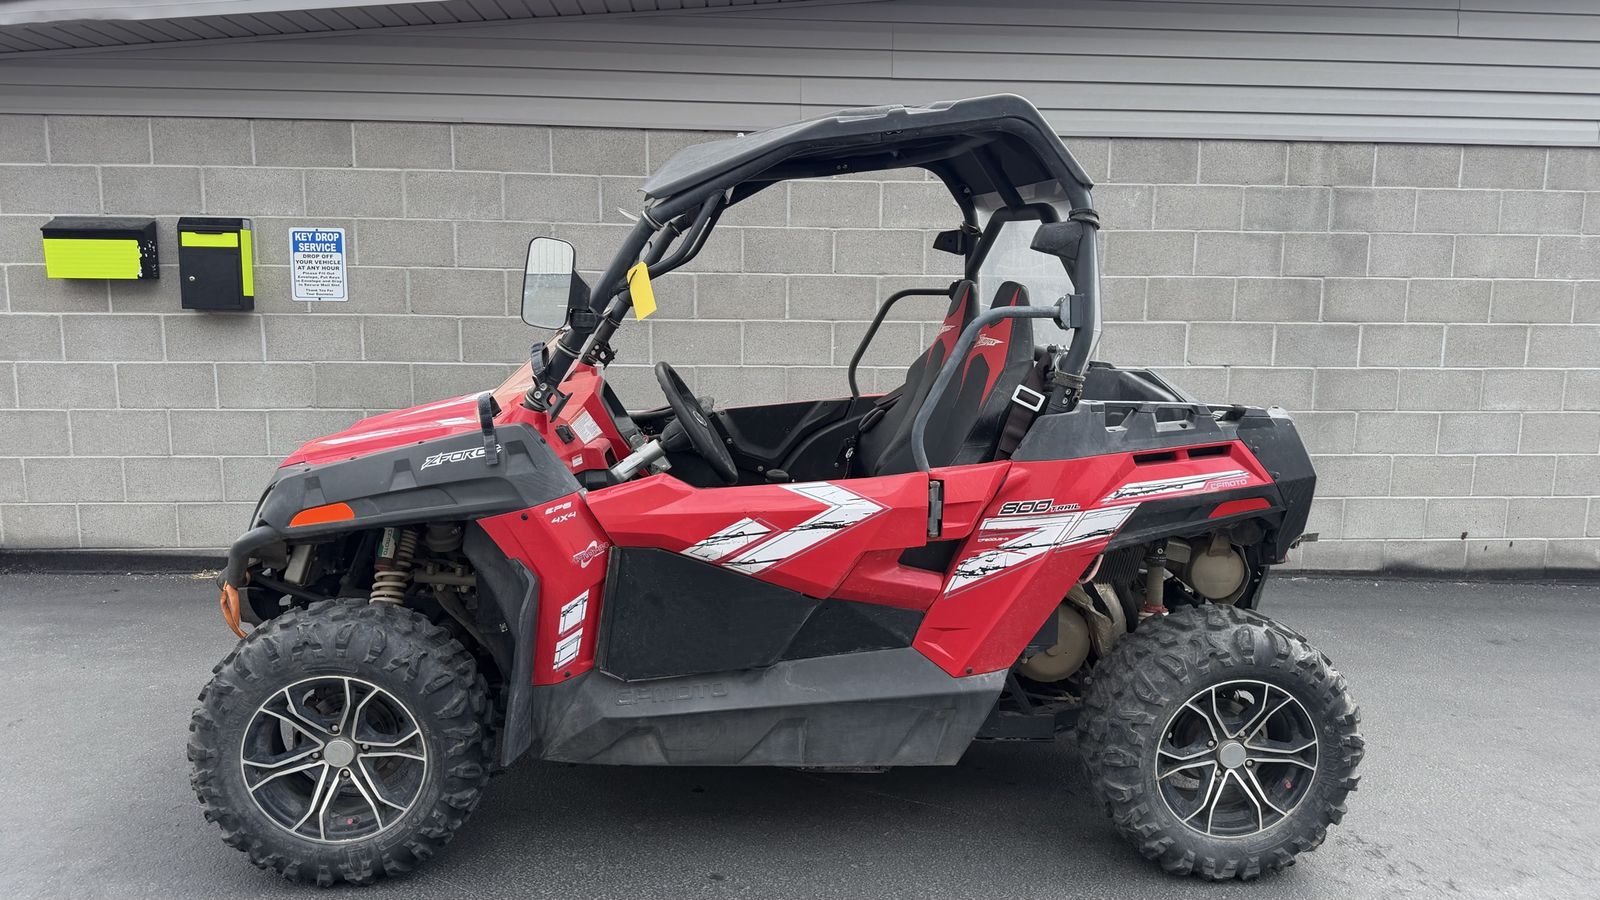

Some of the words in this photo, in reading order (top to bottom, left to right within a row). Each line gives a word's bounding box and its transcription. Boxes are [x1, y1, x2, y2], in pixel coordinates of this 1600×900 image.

[294, 232, 313, 241] KEY
[315, 232, 339, 242] DROP
[298, 242, 337, 252] SERVICE
[1210, 478, 1248, 490] CFMOTO
[544, 501, 572, 515] EPS
[997, 498, 1055, 516] 800
[1050, 502, 1081, 513] TRAIL
